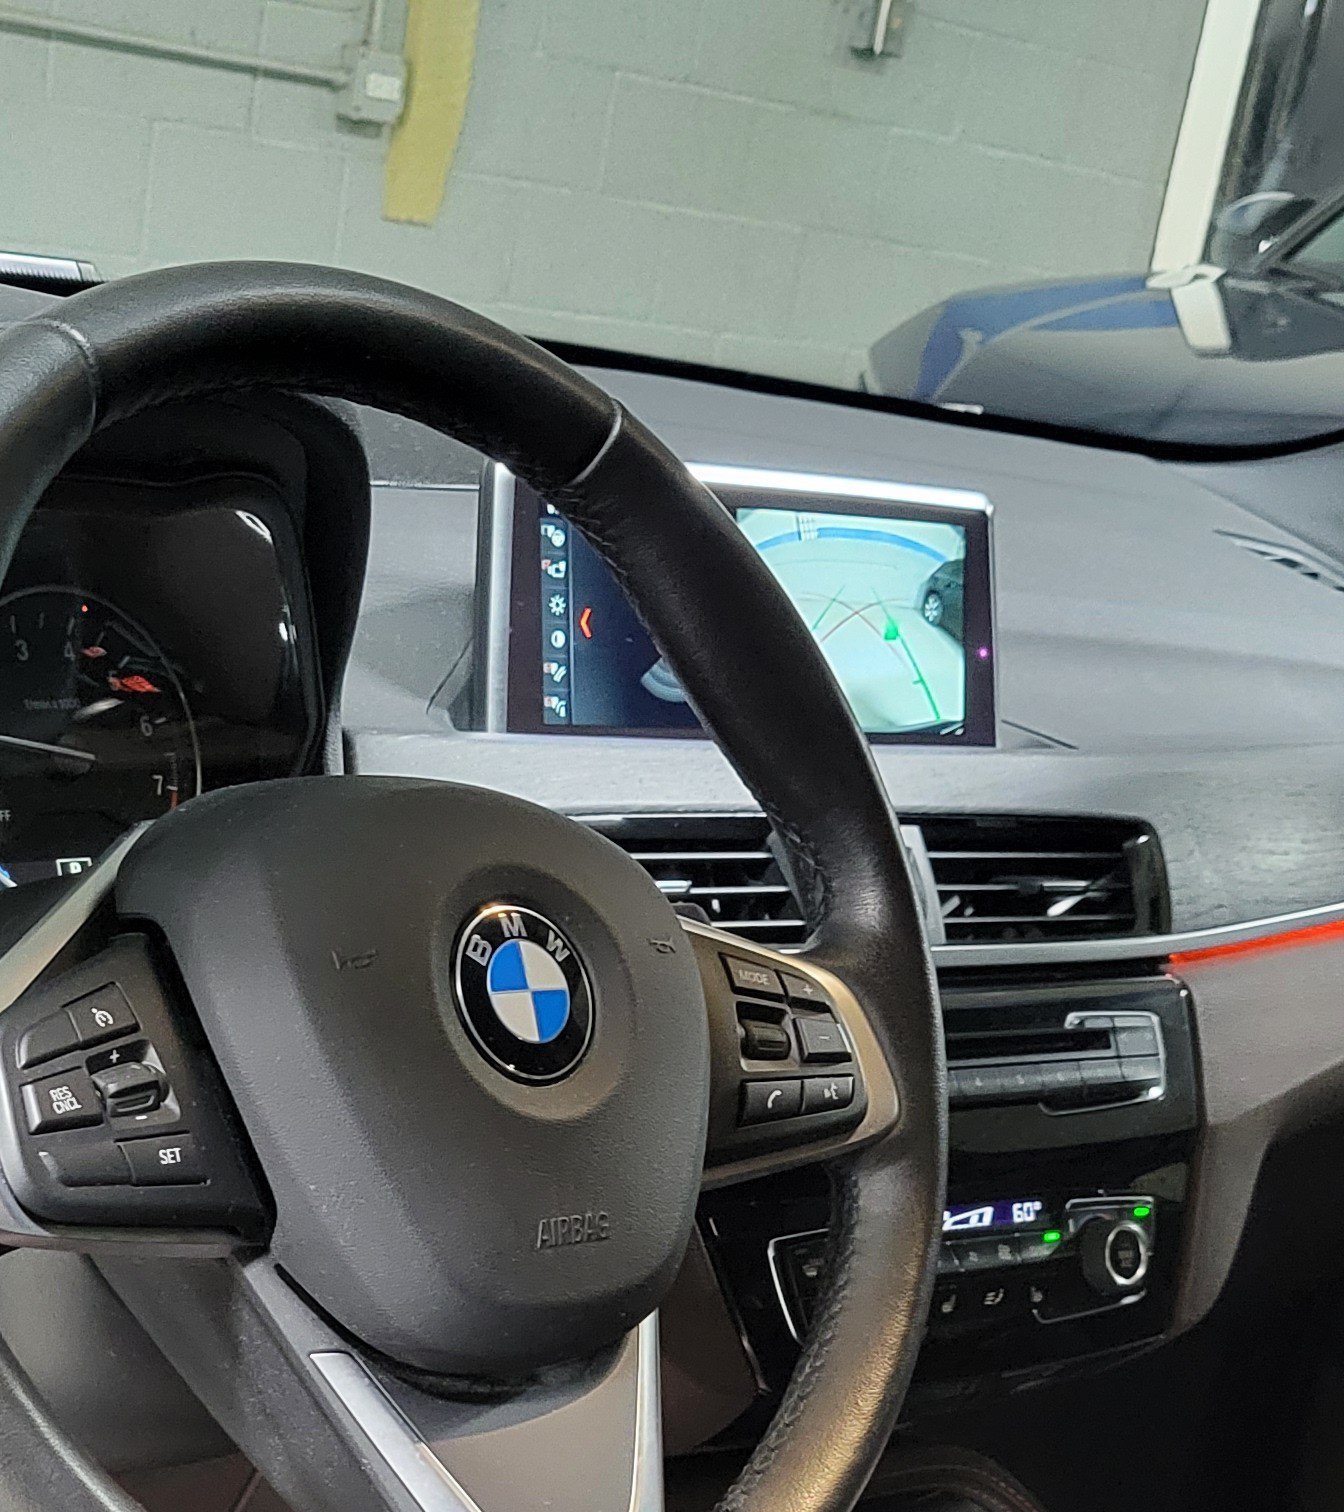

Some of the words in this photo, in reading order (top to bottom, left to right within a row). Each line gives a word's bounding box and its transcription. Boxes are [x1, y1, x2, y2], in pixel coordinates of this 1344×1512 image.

[14, 639, 30, 661] 3
[139, 715, 154, 737] 6
[152, 774, 164, 796] 7
[465, 912, 571, 967] BMW
[738, 969, 770, 986] MODE
[48, 1085, 73, 1101] RES
[52, 1098, 83, 1114] CNCL
[158, 1147, 182, 1165] SET
[536, 1211, 613, 1251] AIRBAG
